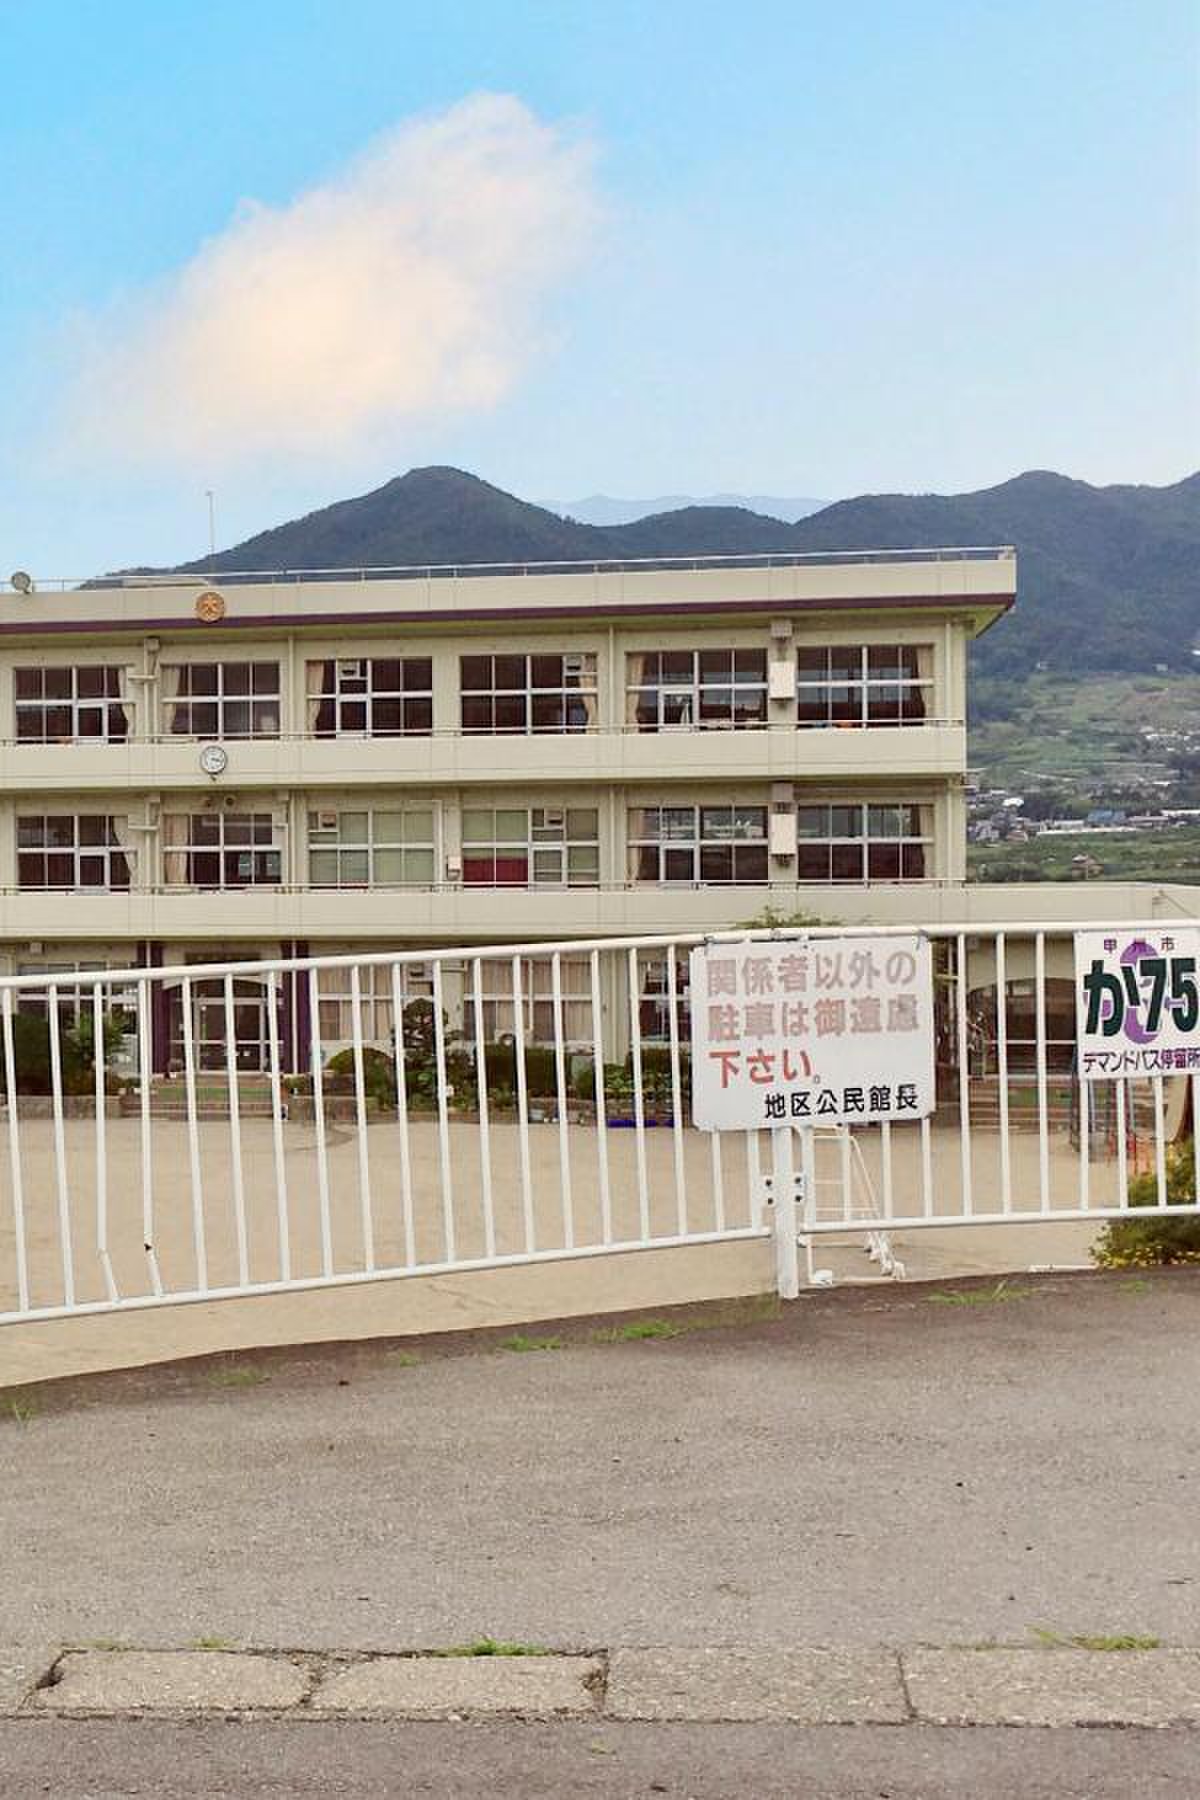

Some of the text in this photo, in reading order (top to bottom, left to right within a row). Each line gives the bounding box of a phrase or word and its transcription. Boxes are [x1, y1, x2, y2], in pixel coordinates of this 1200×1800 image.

[706, 951, 917, 997] 関係者以外の
[707, 994, 920, 1042] 駐車は御遠慮
[708, 1049, 821, 1089] 下さい。
[764, 1083, 919, 1119] 地区公民館長
